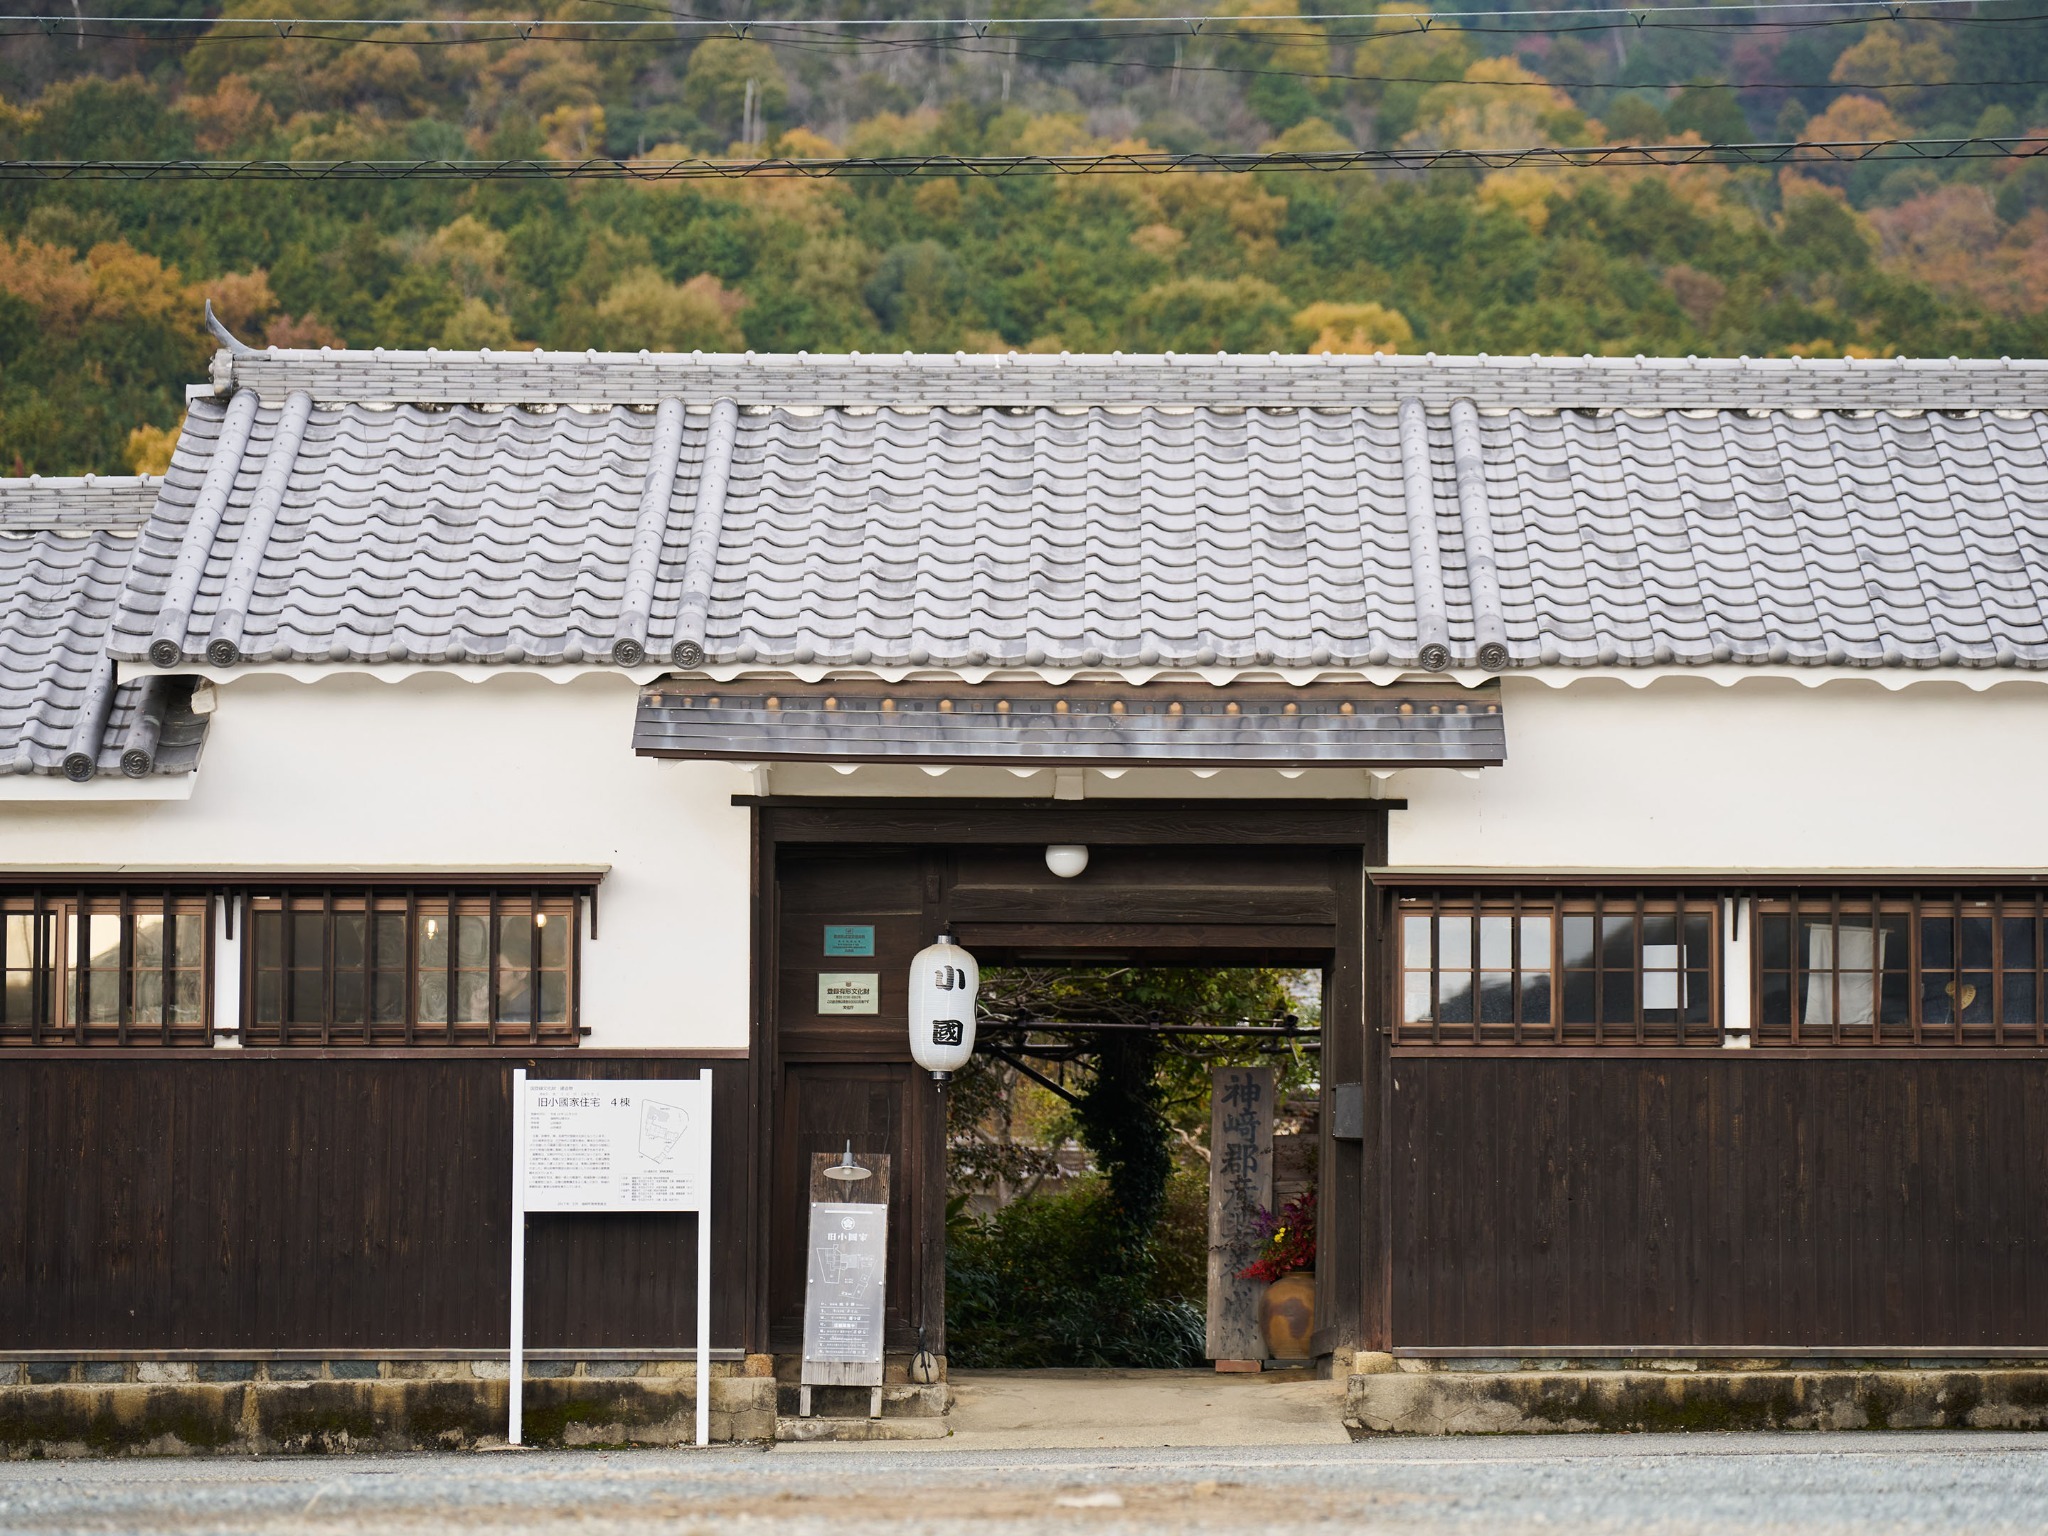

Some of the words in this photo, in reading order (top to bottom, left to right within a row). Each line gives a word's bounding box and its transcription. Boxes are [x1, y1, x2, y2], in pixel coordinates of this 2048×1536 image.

[933, 965, 966, 1046] 小國
[538, 1097, 601, 1108] 旧小國家住宅
